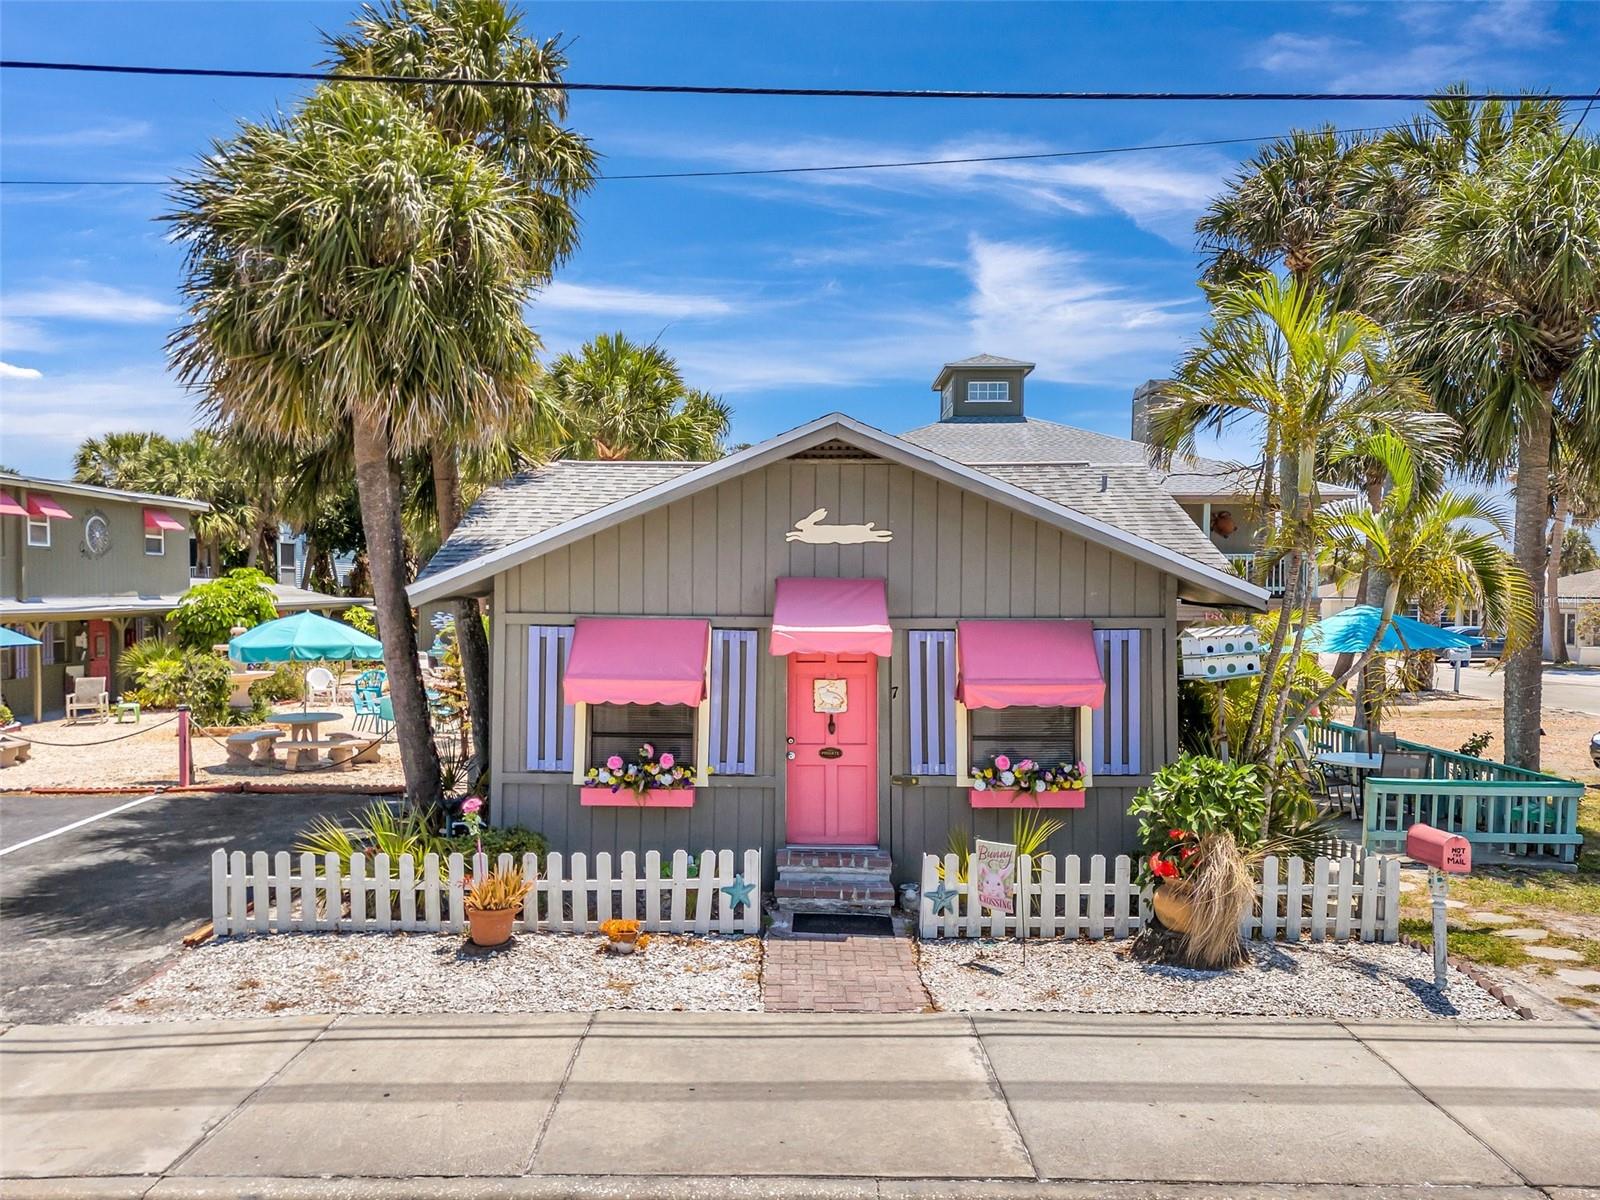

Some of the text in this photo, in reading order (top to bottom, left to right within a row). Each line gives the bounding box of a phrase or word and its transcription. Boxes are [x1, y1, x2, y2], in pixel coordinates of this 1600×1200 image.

[890, 686, 899, 699] 7
[978, 844, 1012, 869] Bunny
[1447, 857, 1466, 866] MAIL
[978, 894, 1012, 909] CROSSING
